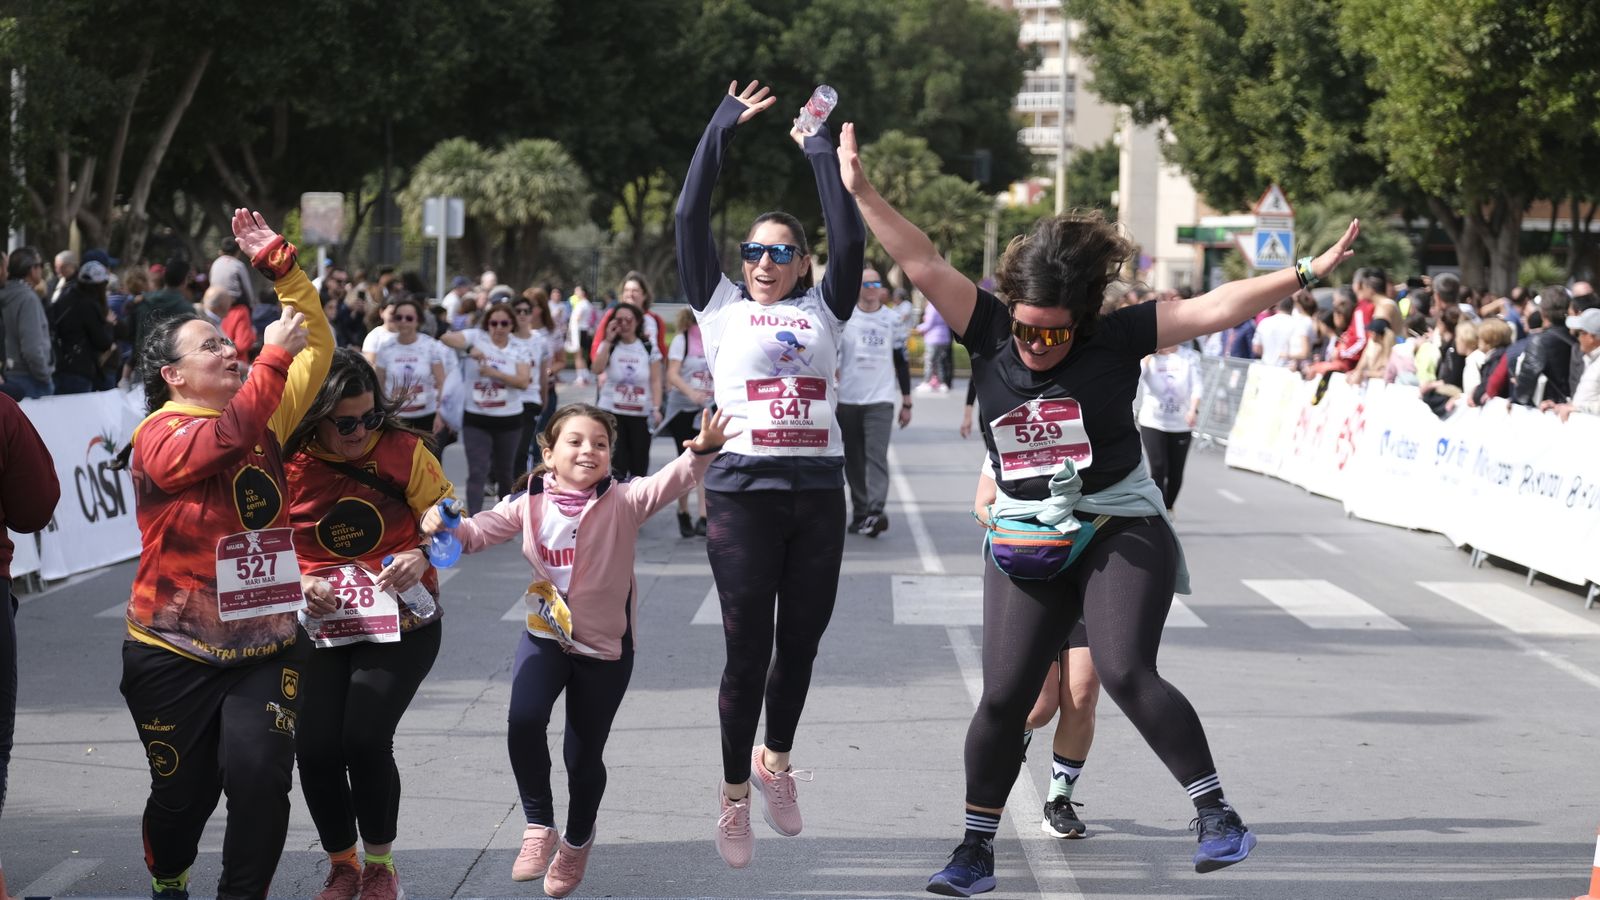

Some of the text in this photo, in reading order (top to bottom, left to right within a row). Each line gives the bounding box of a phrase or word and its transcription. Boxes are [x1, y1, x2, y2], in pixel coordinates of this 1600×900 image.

[750, 314, 811, 329] MUJER
[769, 399, 811, 420] 647
[1014, 422, 1063, 444] 529
[1028, 440, 1056, 448] CONSTA
[236, 553, 278, 580] 527
[344, 608, 359, 616] NOE
[242, 643, 278, 657] LUCHA
